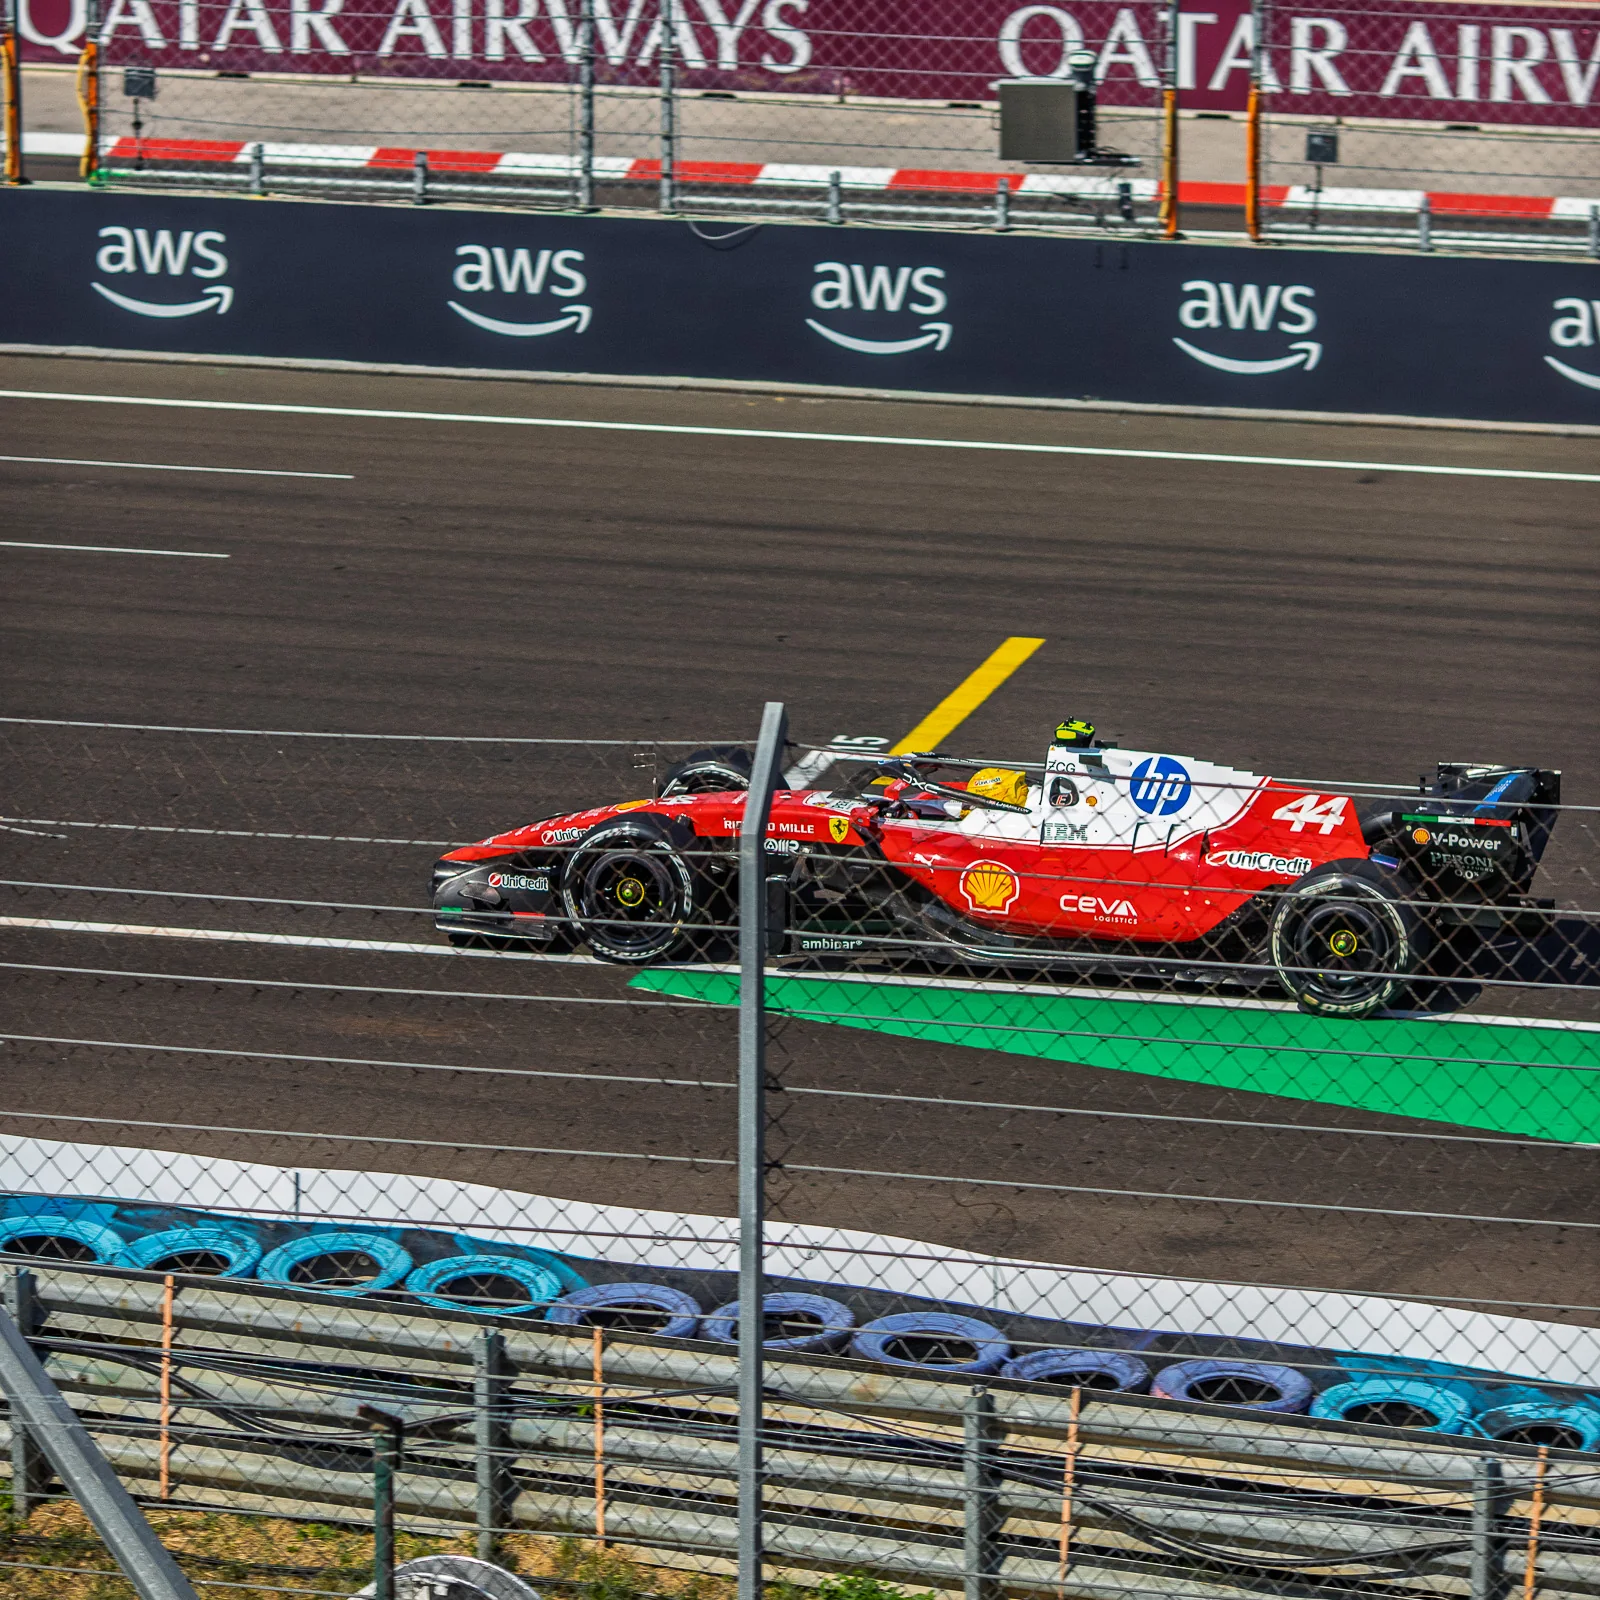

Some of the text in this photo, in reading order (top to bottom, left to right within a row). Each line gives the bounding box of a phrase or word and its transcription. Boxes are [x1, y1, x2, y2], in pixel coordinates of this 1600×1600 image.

[998, 5, 1352, 97] QATAR
[97, 226, 228, 278] aws
[454, 244, 586, 297] aws
[812, 261, 946, 315] aws
[1179, 280, 1316, 334] aws
[1133, 756, 1189, 815] hp
[779, 822, 815, 835] MILLE
[1271, 794, 1349, 835] 44
[1044, 823, 1089, 841] IBM
[1431, 832, 1502, 850] V-Power
[1228, 852, 1311, 875] UniCredit
[1430, 852, 1494, 868] PERONI
[502, 875, 549, 891] UniCredit
[1094, 915, 1138, 925] LOGISTICS
